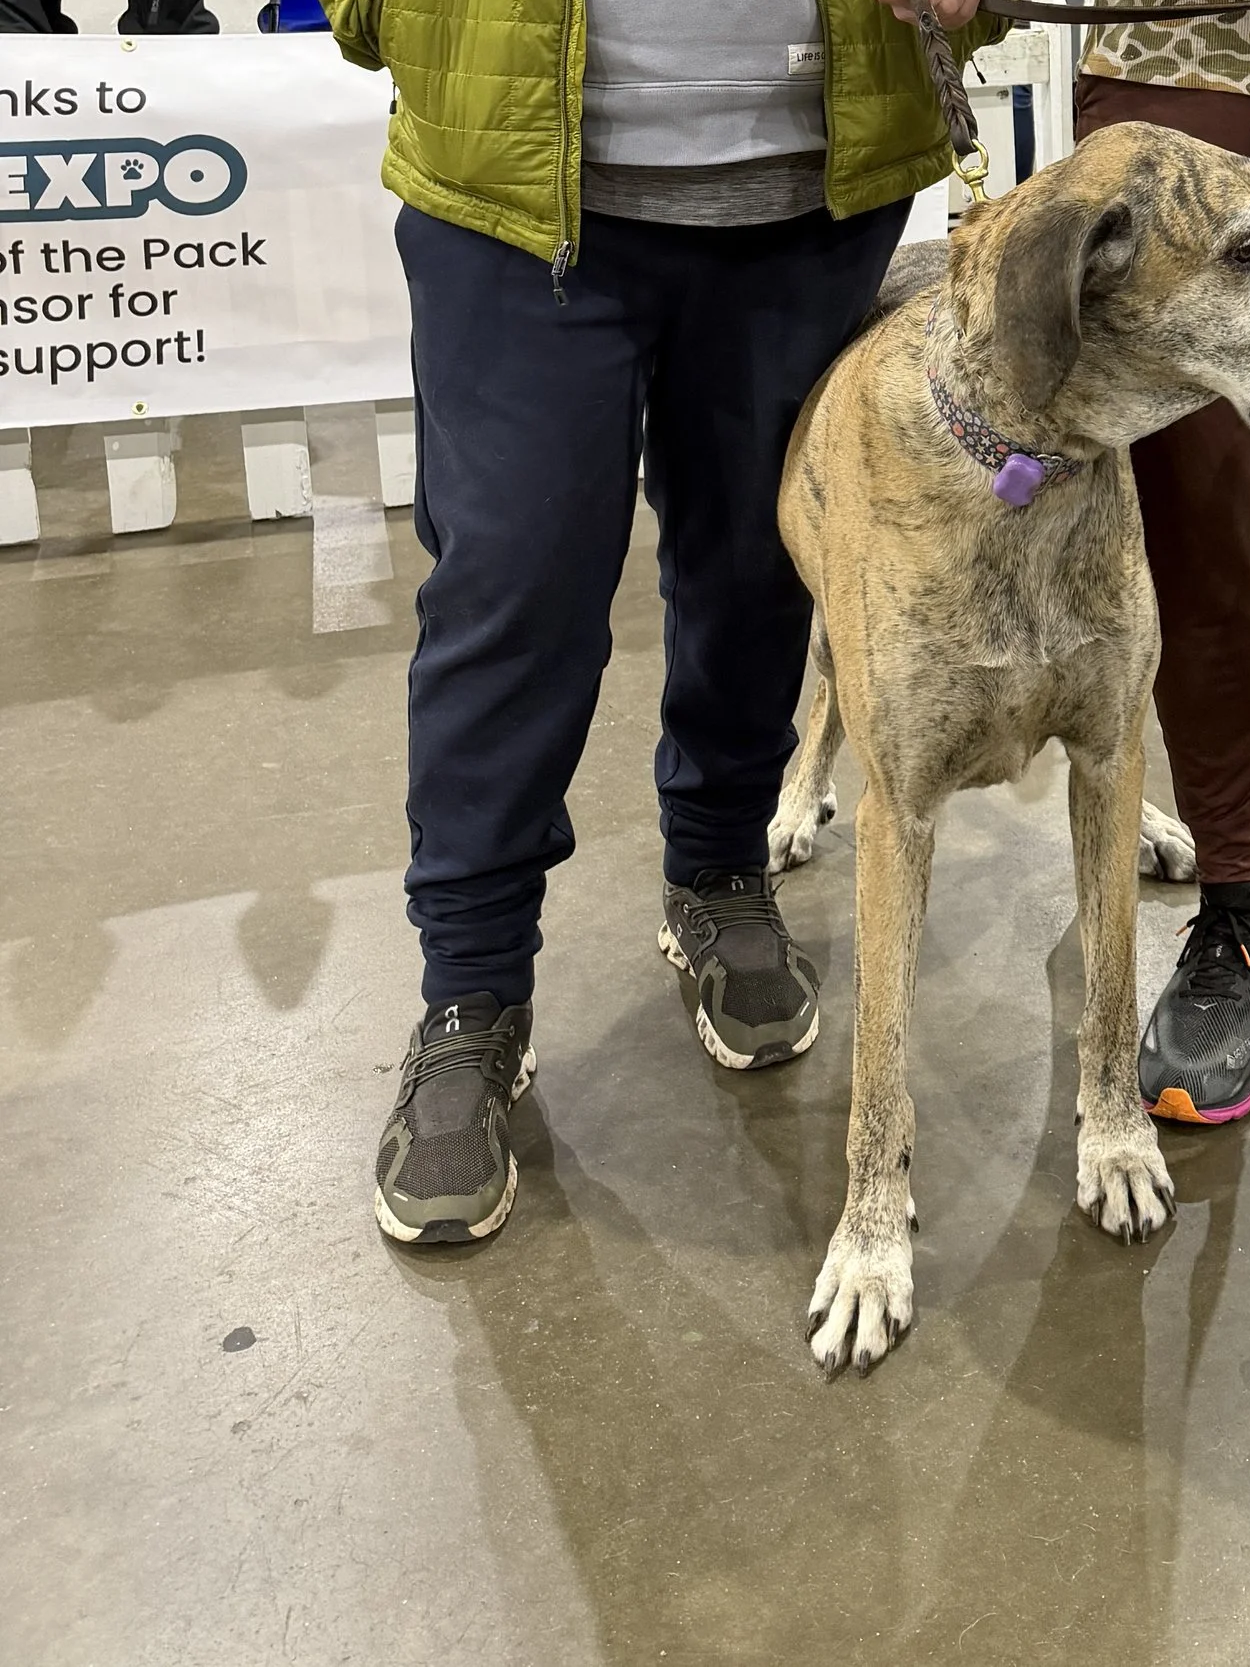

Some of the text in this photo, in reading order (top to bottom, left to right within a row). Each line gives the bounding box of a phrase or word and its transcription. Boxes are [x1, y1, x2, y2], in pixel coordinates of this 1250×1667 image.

[96, 82, 147, 114] to
[0, 148, 231, 211] EXPO
[40, 239, 126, 274] the
[143, 231, 267, 270] Pack
[108, 283, 178, 318] for
